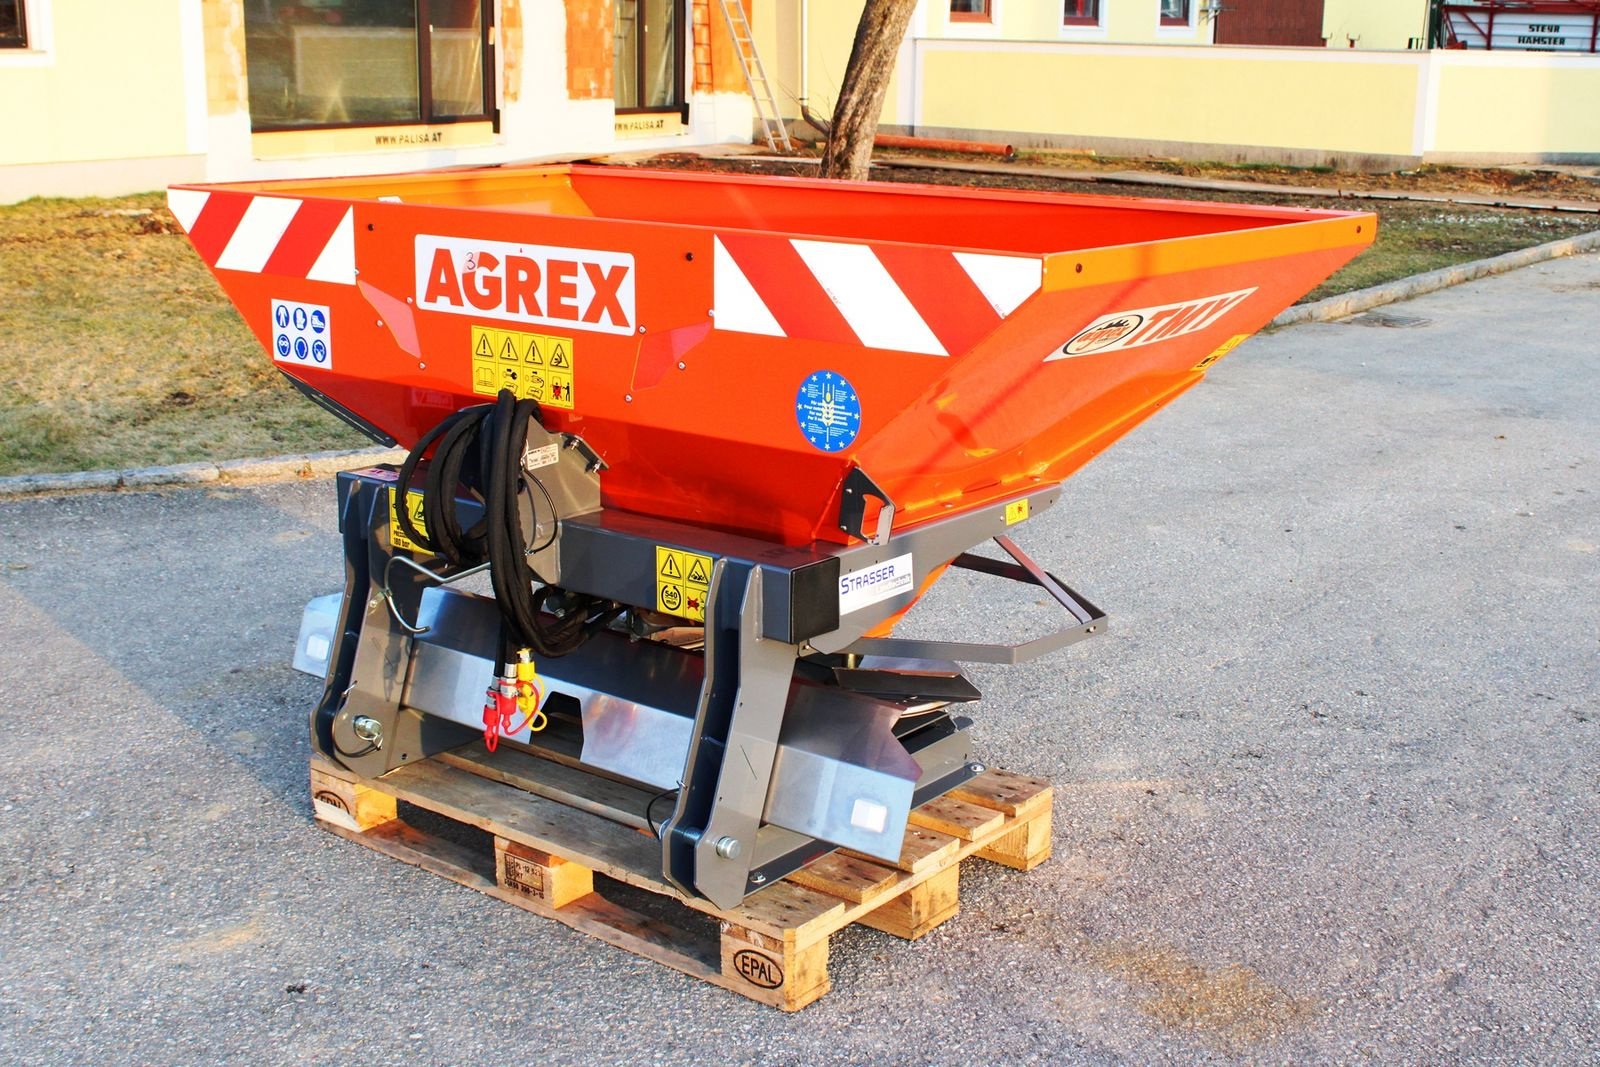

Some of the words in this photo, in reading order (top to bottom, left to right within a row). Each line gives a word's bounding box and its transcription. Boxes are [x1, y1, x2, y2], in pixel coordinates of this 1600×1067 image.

[1517, 35, 1566, 45] HAMSTER
[424, 248, 631, 328] AGREX
[1123, 293, 1250, 346] TMY
[402, 539, 410, 548] bar
[664, 590, 678, 599] 540
[841, 565, 895, 595] STRASSER
[741, 954, 777, 985] EPAL
